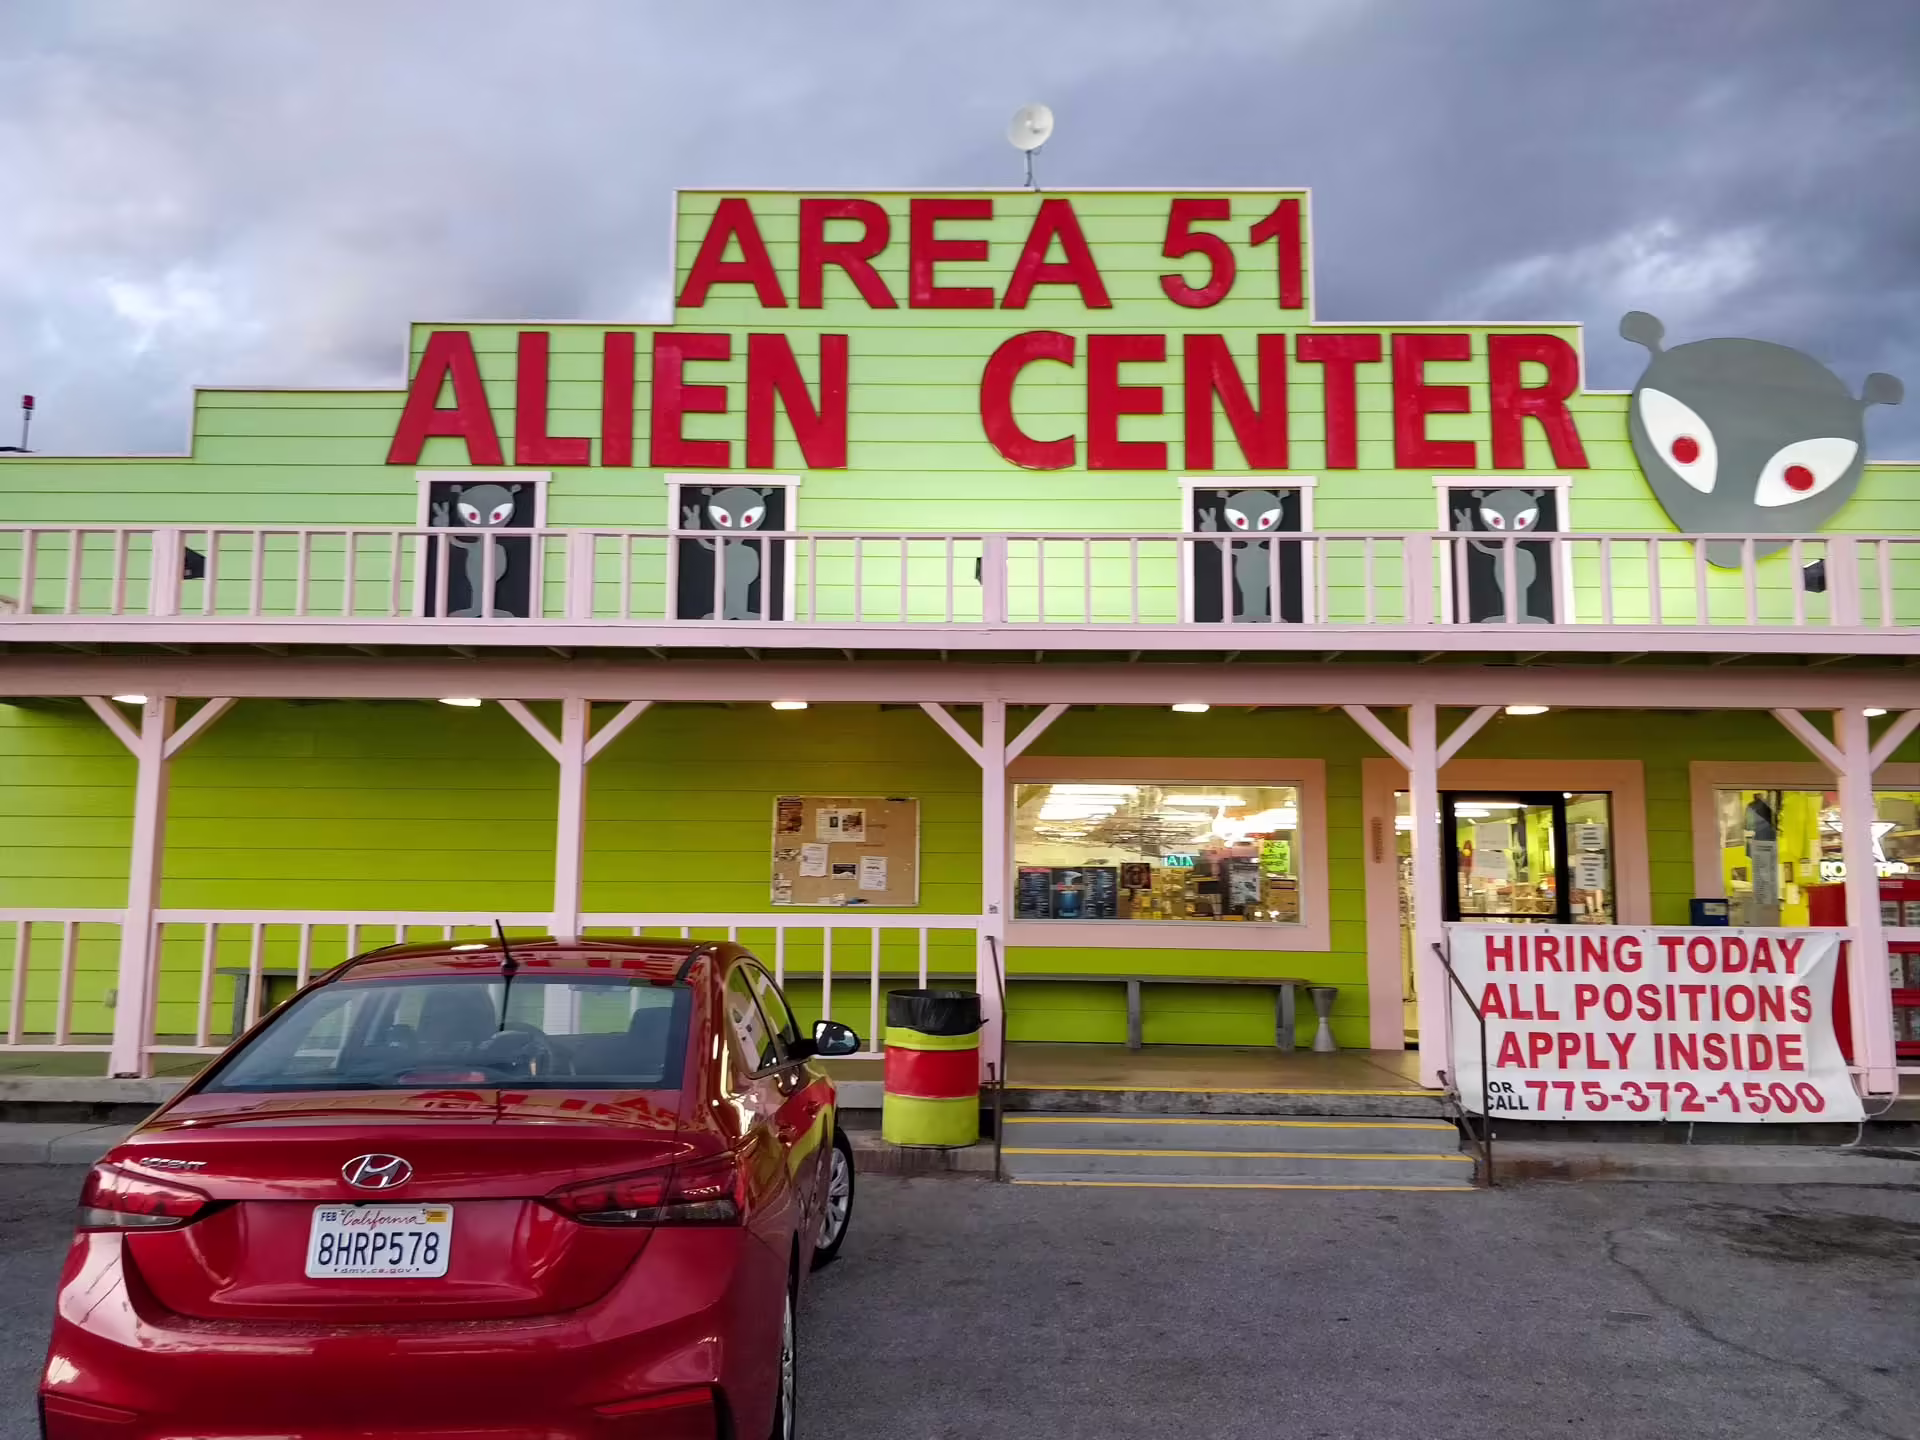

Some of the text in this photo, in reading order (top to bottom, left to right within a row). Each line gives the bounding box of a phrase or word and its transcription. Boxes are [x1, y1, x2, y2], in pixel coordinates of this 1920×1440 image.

[677, 198, 1304, 310] AREA 51
[386, 331, 1590, 471] ALIEN CENTER
[1485, 935, 1804, 975] HIRING TODAY
[1478, 983, 1812, 1023] ALL POSITIONS
[1497, 1031, 1804, 1071] APPLY INSIDE
[1486, 1080, 1825, 1114] CALL 775-372-1500
[1488, 1081, 1515, 1094] OR
[320, 1211, 337, 1222] FEB
[341, 1209, 427, 1230] California
[317, 1231, 440, 1266] 8HRP578
